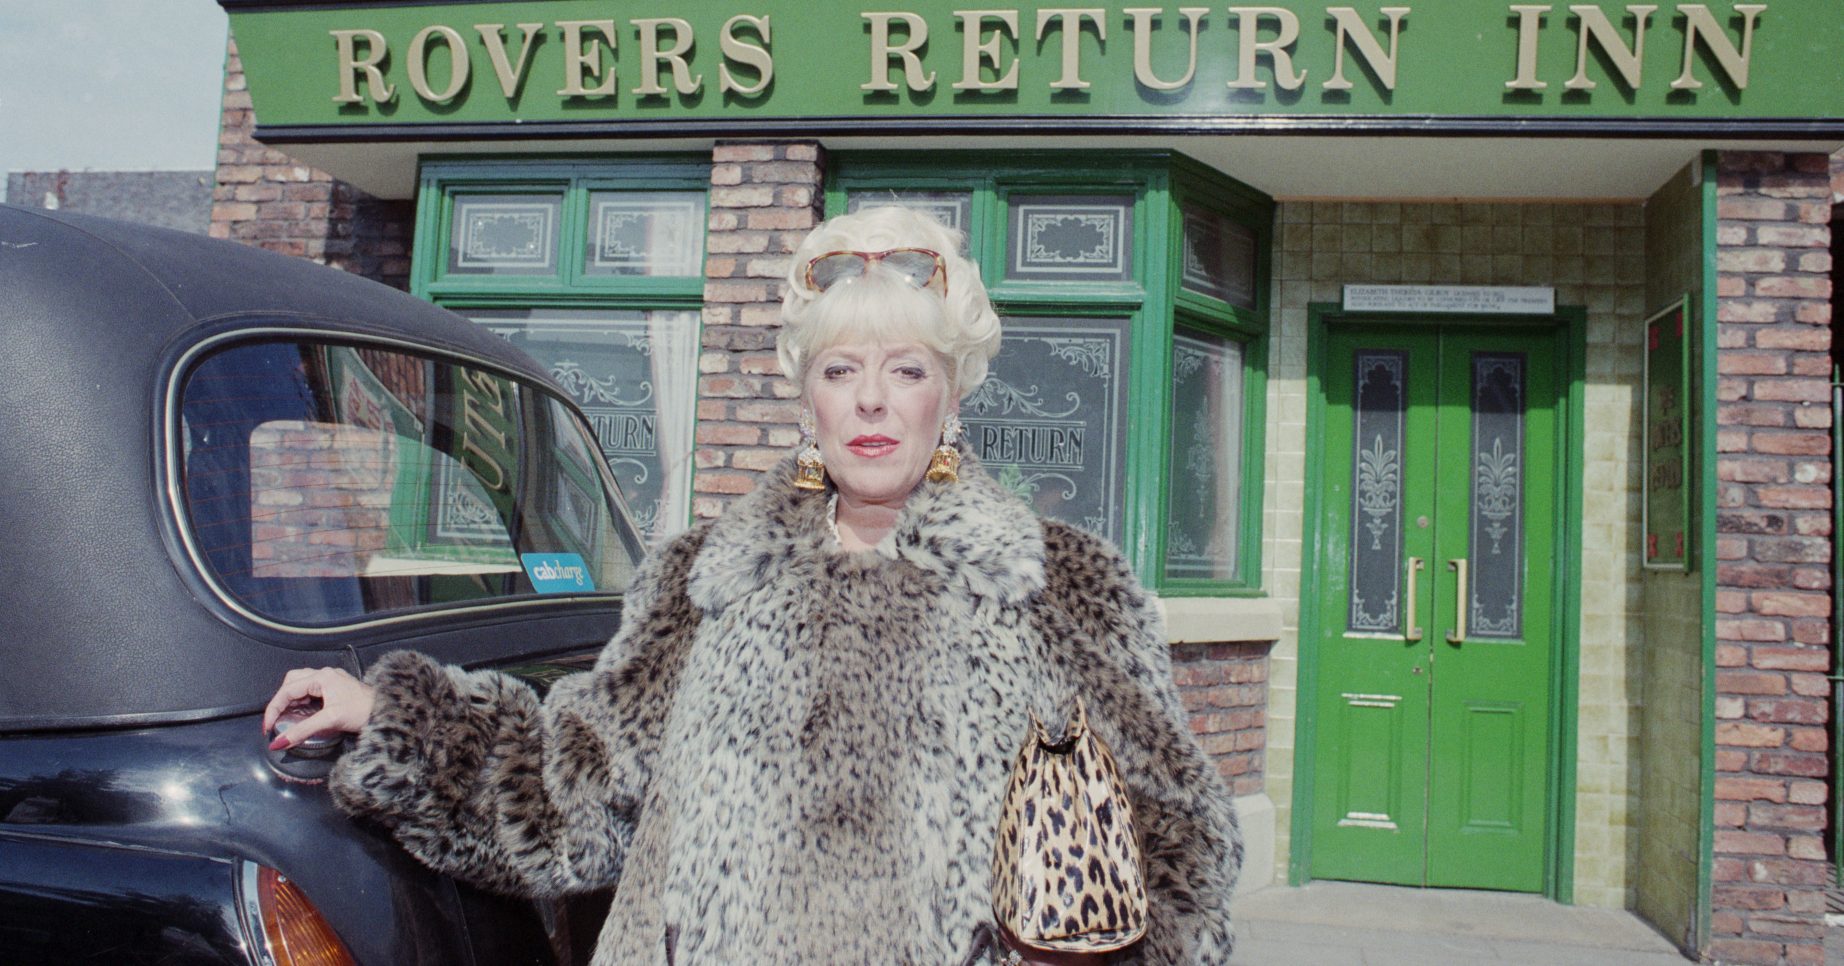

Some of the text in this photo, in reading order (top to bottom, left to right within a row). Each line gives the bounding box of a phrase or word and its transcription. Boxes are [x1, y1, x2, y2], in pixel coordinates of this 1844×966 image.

[329, 4, 1768, 103] ROVERS RETURN INN
[980, 424, 1086, 465] RETURN
[533, 559, 584, 587] cabcharge
